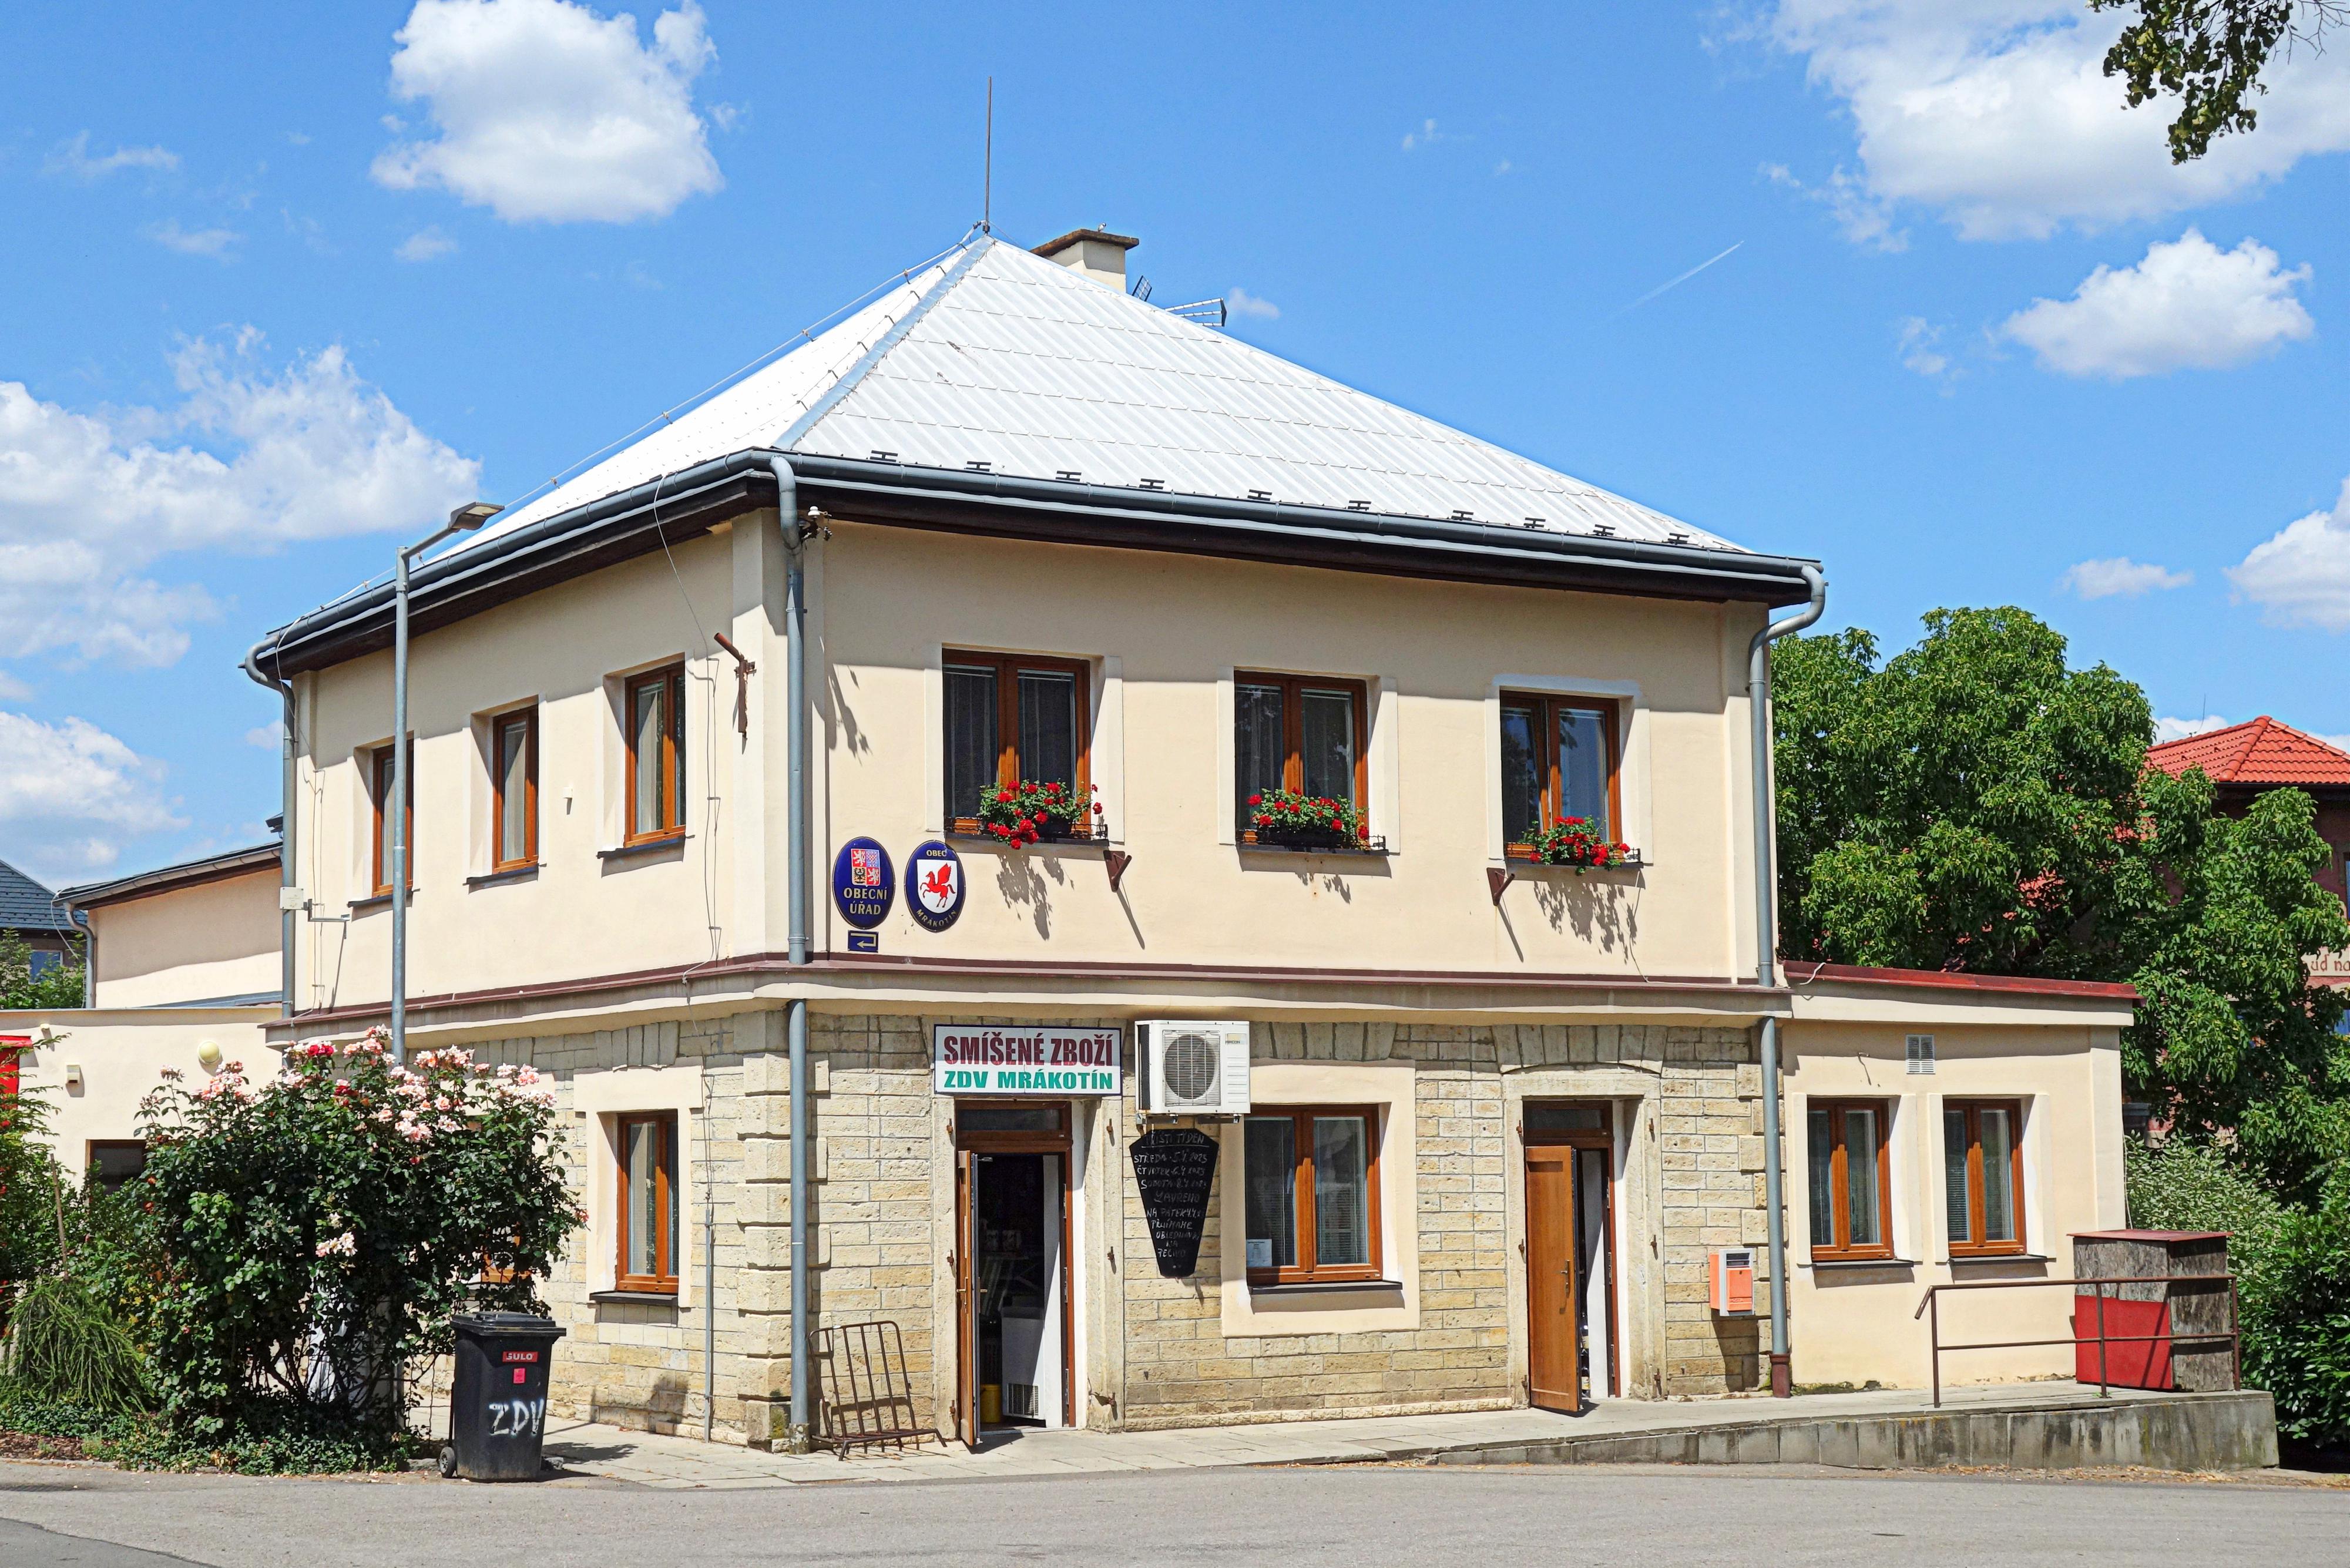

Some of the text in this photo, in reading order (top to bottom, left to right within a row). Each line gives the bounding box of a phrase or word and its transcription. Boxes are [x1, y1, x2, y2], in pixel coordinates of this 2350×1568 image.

[844, 886, 887, 900] OBECNÍ
[850, 901, 881, 915] ÚŘAD
[916, 909, 957, 927] MRÁKOTÍN
[944, 1032, 1114, 1067] SMÍŠENÉ ZBOŽÍ
[944, 1069, 1113, 1090] ZDV MRÁKOTÍN
[1147, 1208, 1157, 1218] NA
[489, 1399, 544, 1435] ZDV
